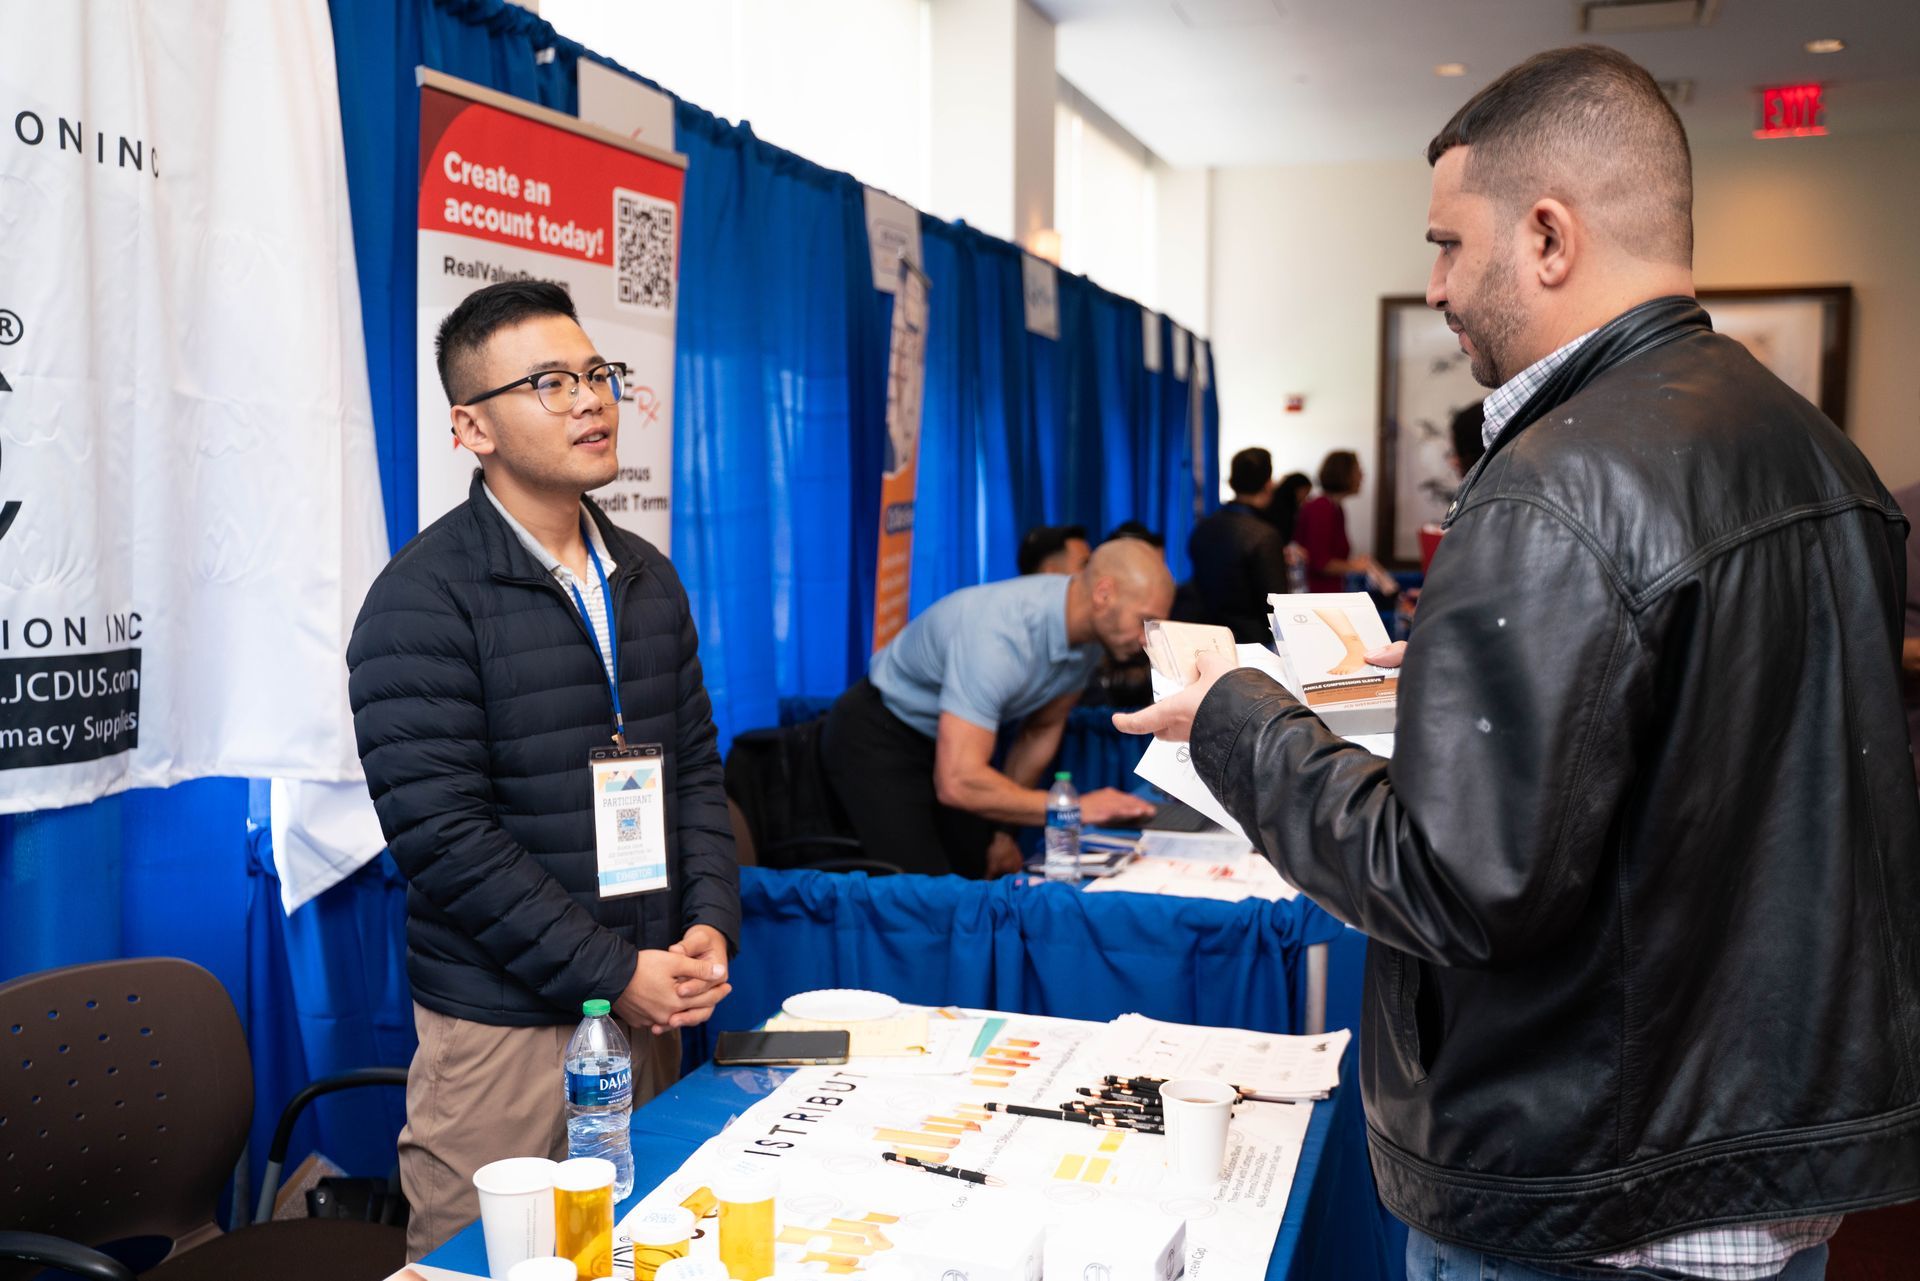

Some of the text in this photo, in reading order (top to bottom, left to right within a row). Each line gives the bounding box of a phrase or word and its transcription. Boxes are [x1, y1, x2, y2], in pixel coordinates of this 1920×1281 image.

[443, 151, 552, 206] Create an
[444, 197, 605, 259] account today!
[592, 492, 628, 512] redit
[2, 612, 142, 650] ION INC
[84, 710, 137, 744] Supplies
[603, 794, 652, 808] PARTICIPANT
